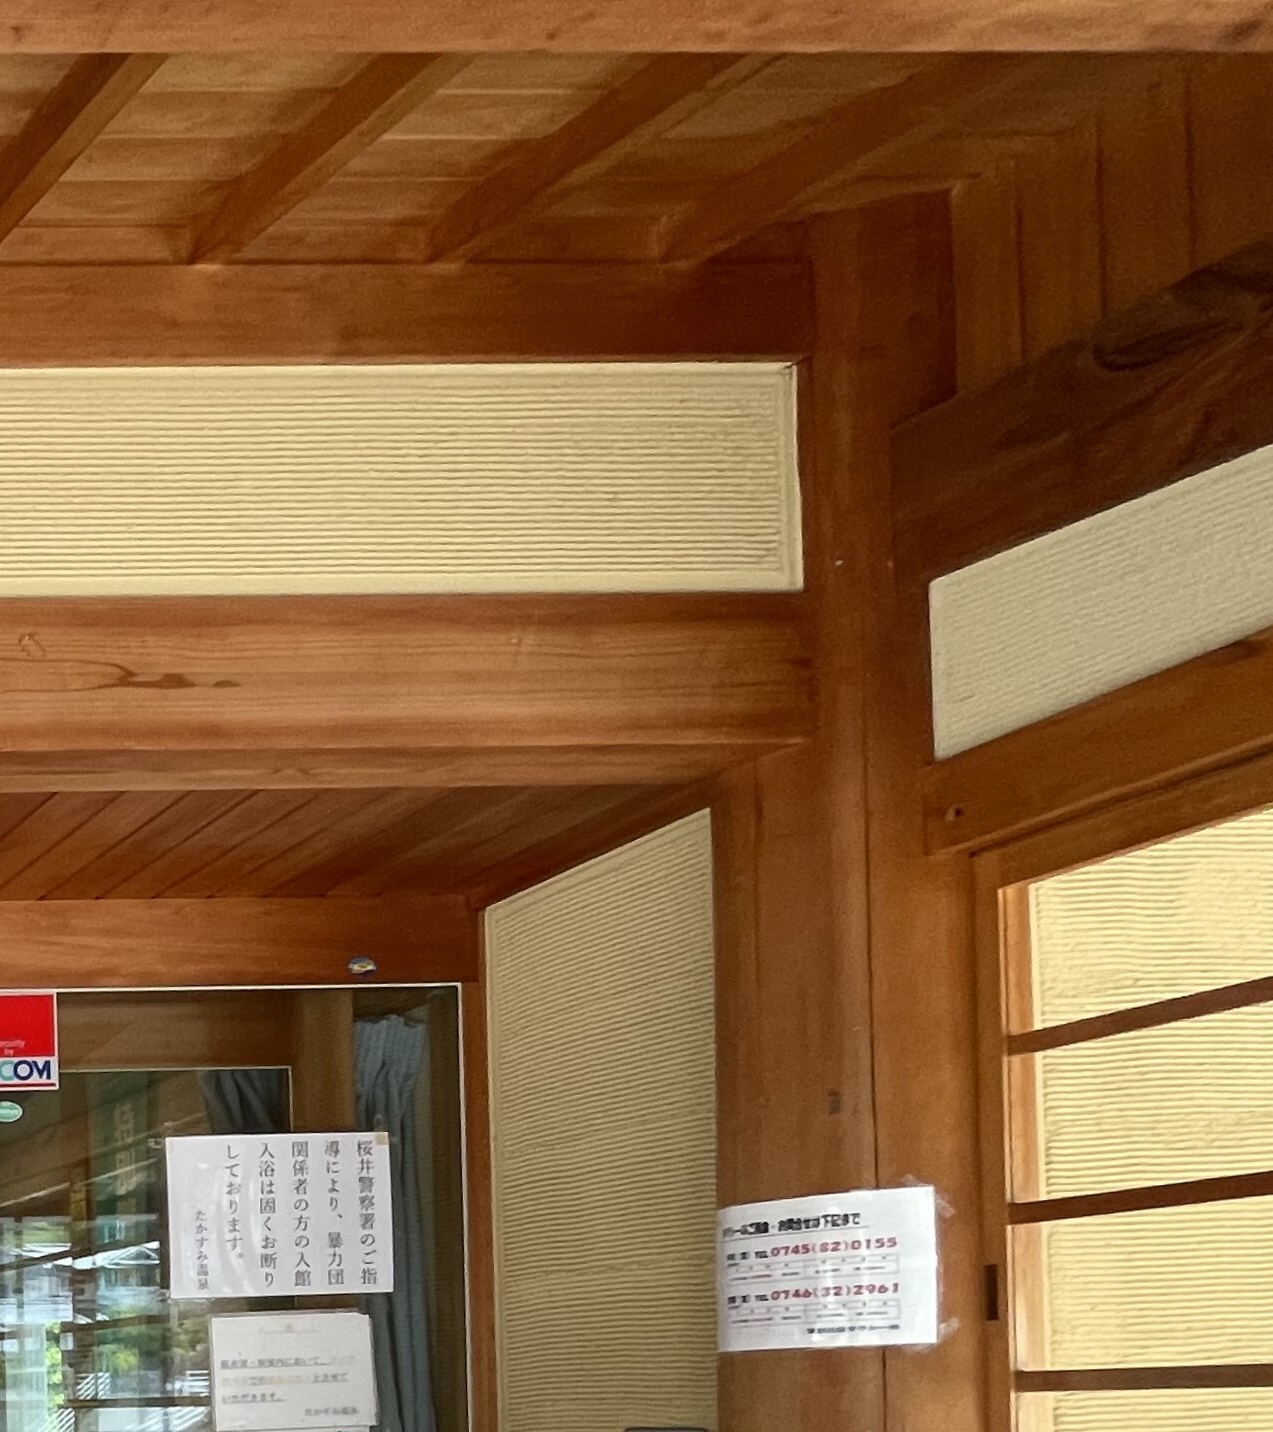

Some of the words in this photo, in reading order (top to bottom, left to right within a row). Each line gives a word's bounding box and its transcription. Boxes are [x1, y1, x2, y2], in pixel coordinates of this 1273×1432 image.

[225, 1144, 244, 1260] しております。
[259, 1142, 277, 1287] 入浴は固くお断り
[292, 1141, 311, 1287] 関係者の方の入館
[324, 1140, 344, 1285] 導により、暴力団
[356, 1140, 377, 1285] 桜井警察署のご指
